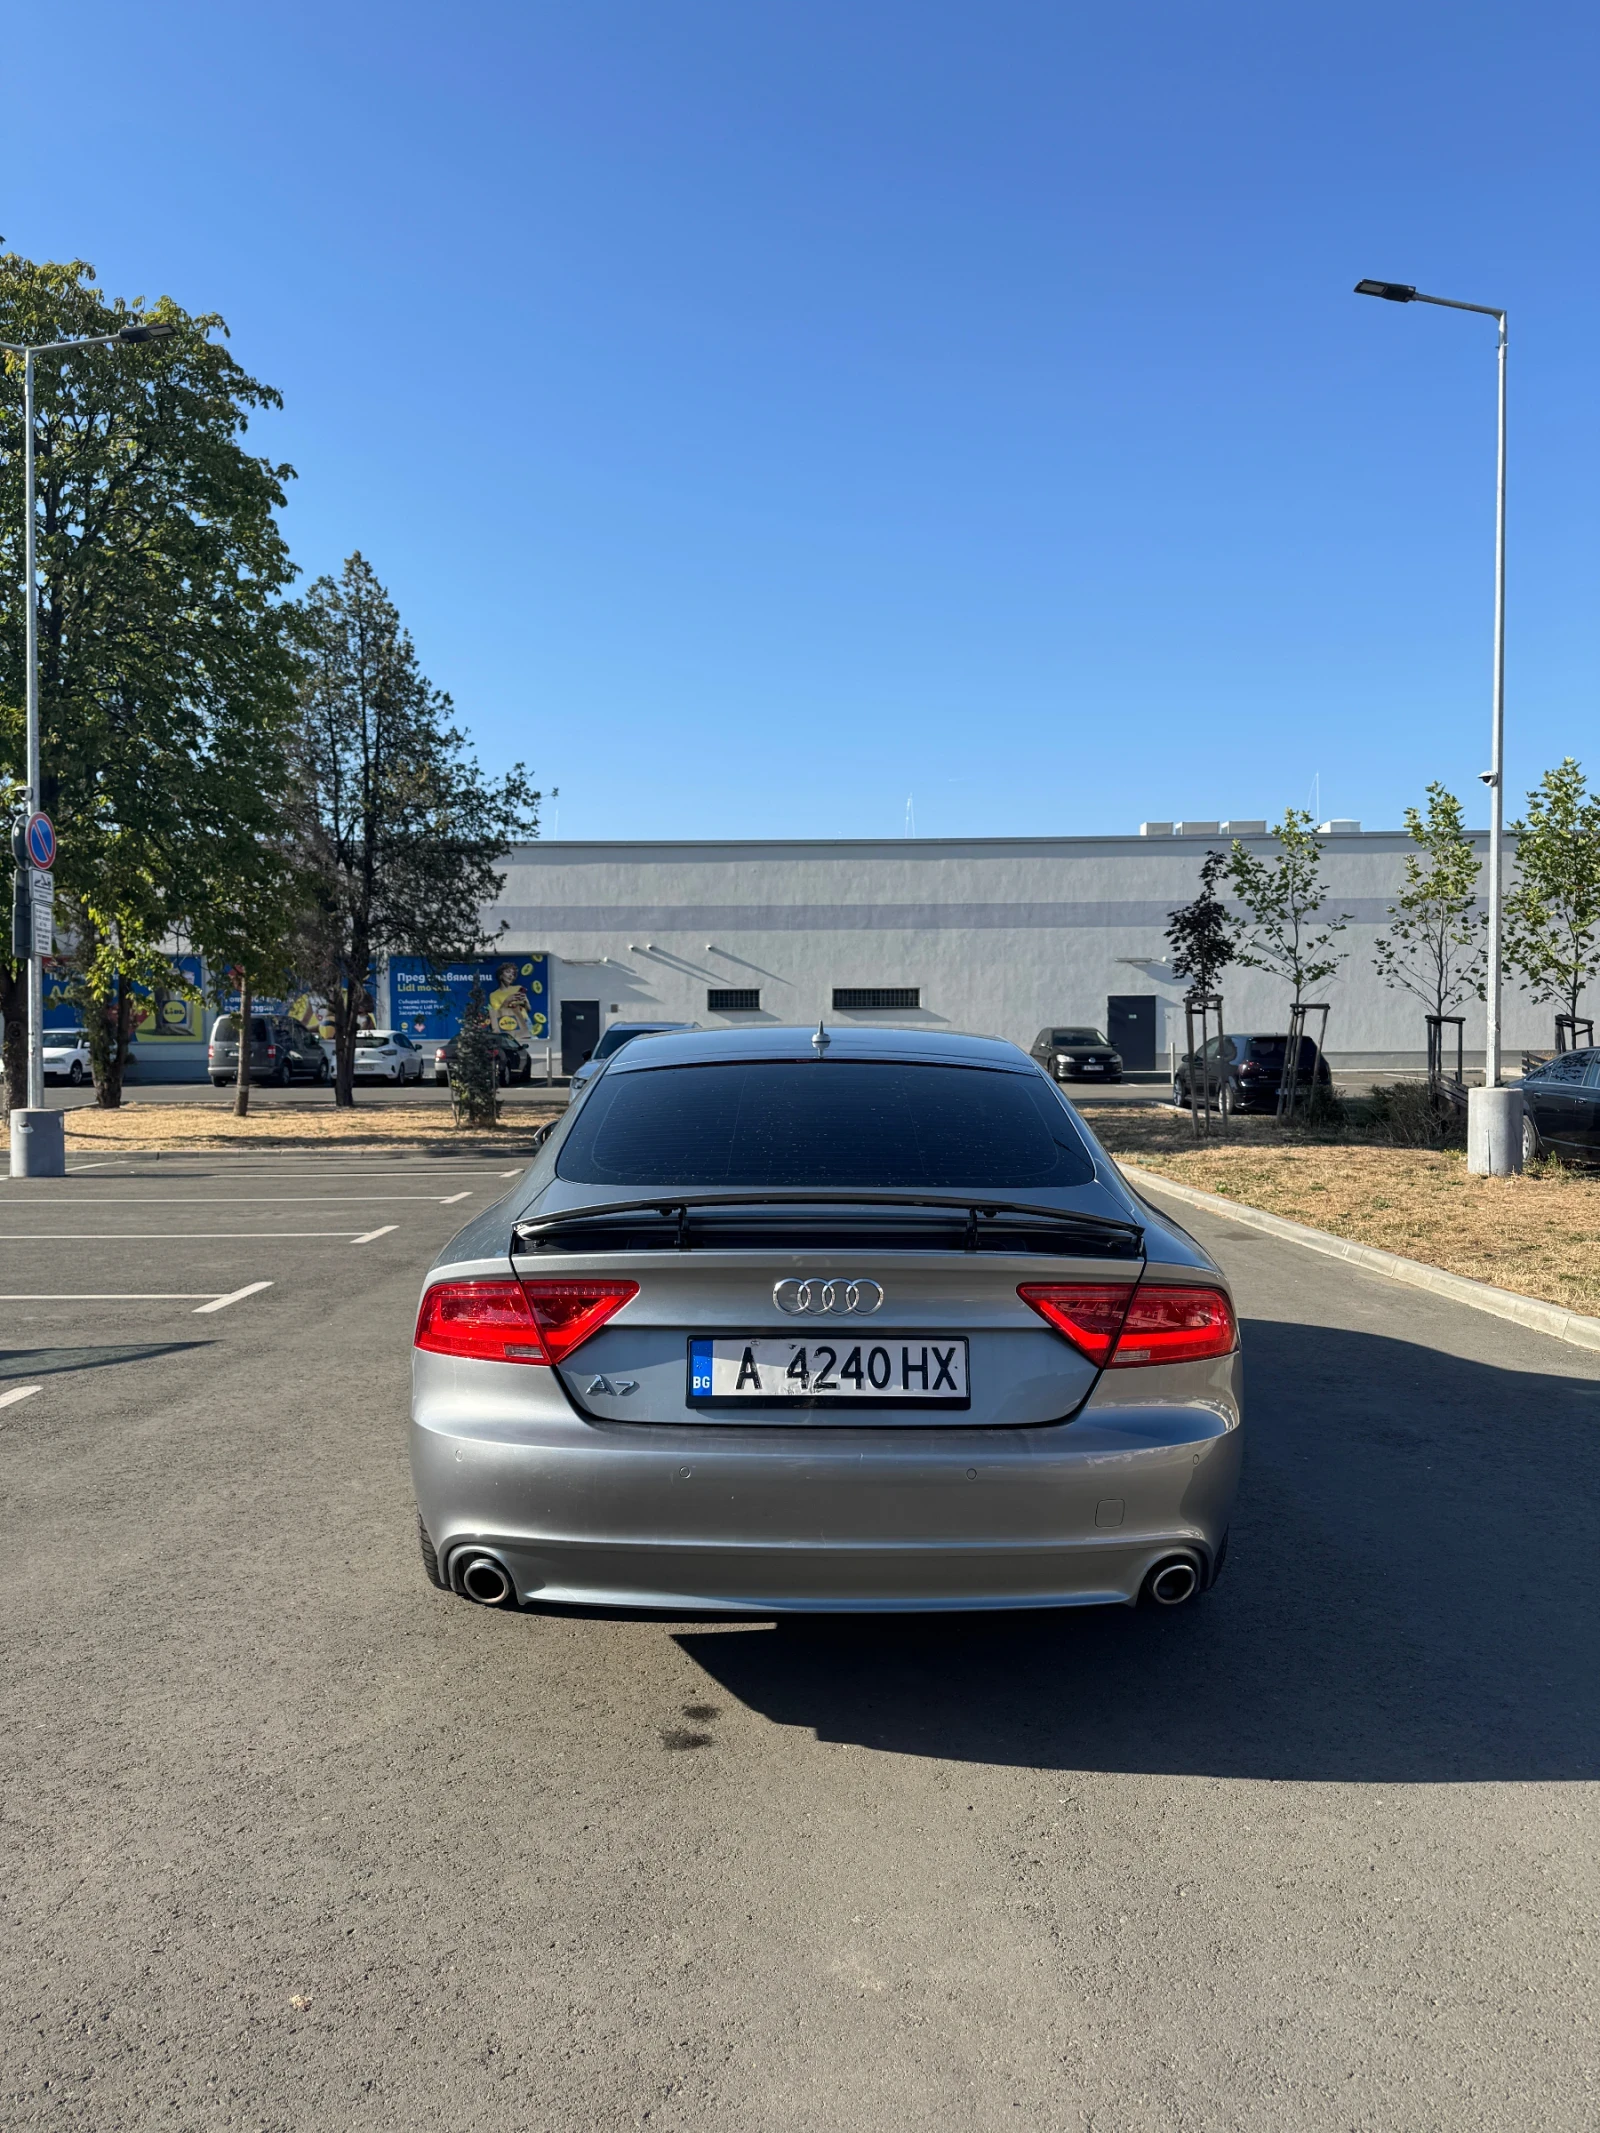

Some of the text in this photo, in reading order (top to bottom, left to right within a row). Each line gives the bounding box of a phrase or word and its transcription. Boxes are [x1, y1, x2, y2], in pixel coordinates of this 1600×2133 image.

[397, 983, 415, 992] Lidl
[735, 1346, 958, 1390] A 4240 HX
[585, 1373, 640, 1397] A7
[692, 1376, 711, 1389] BG
